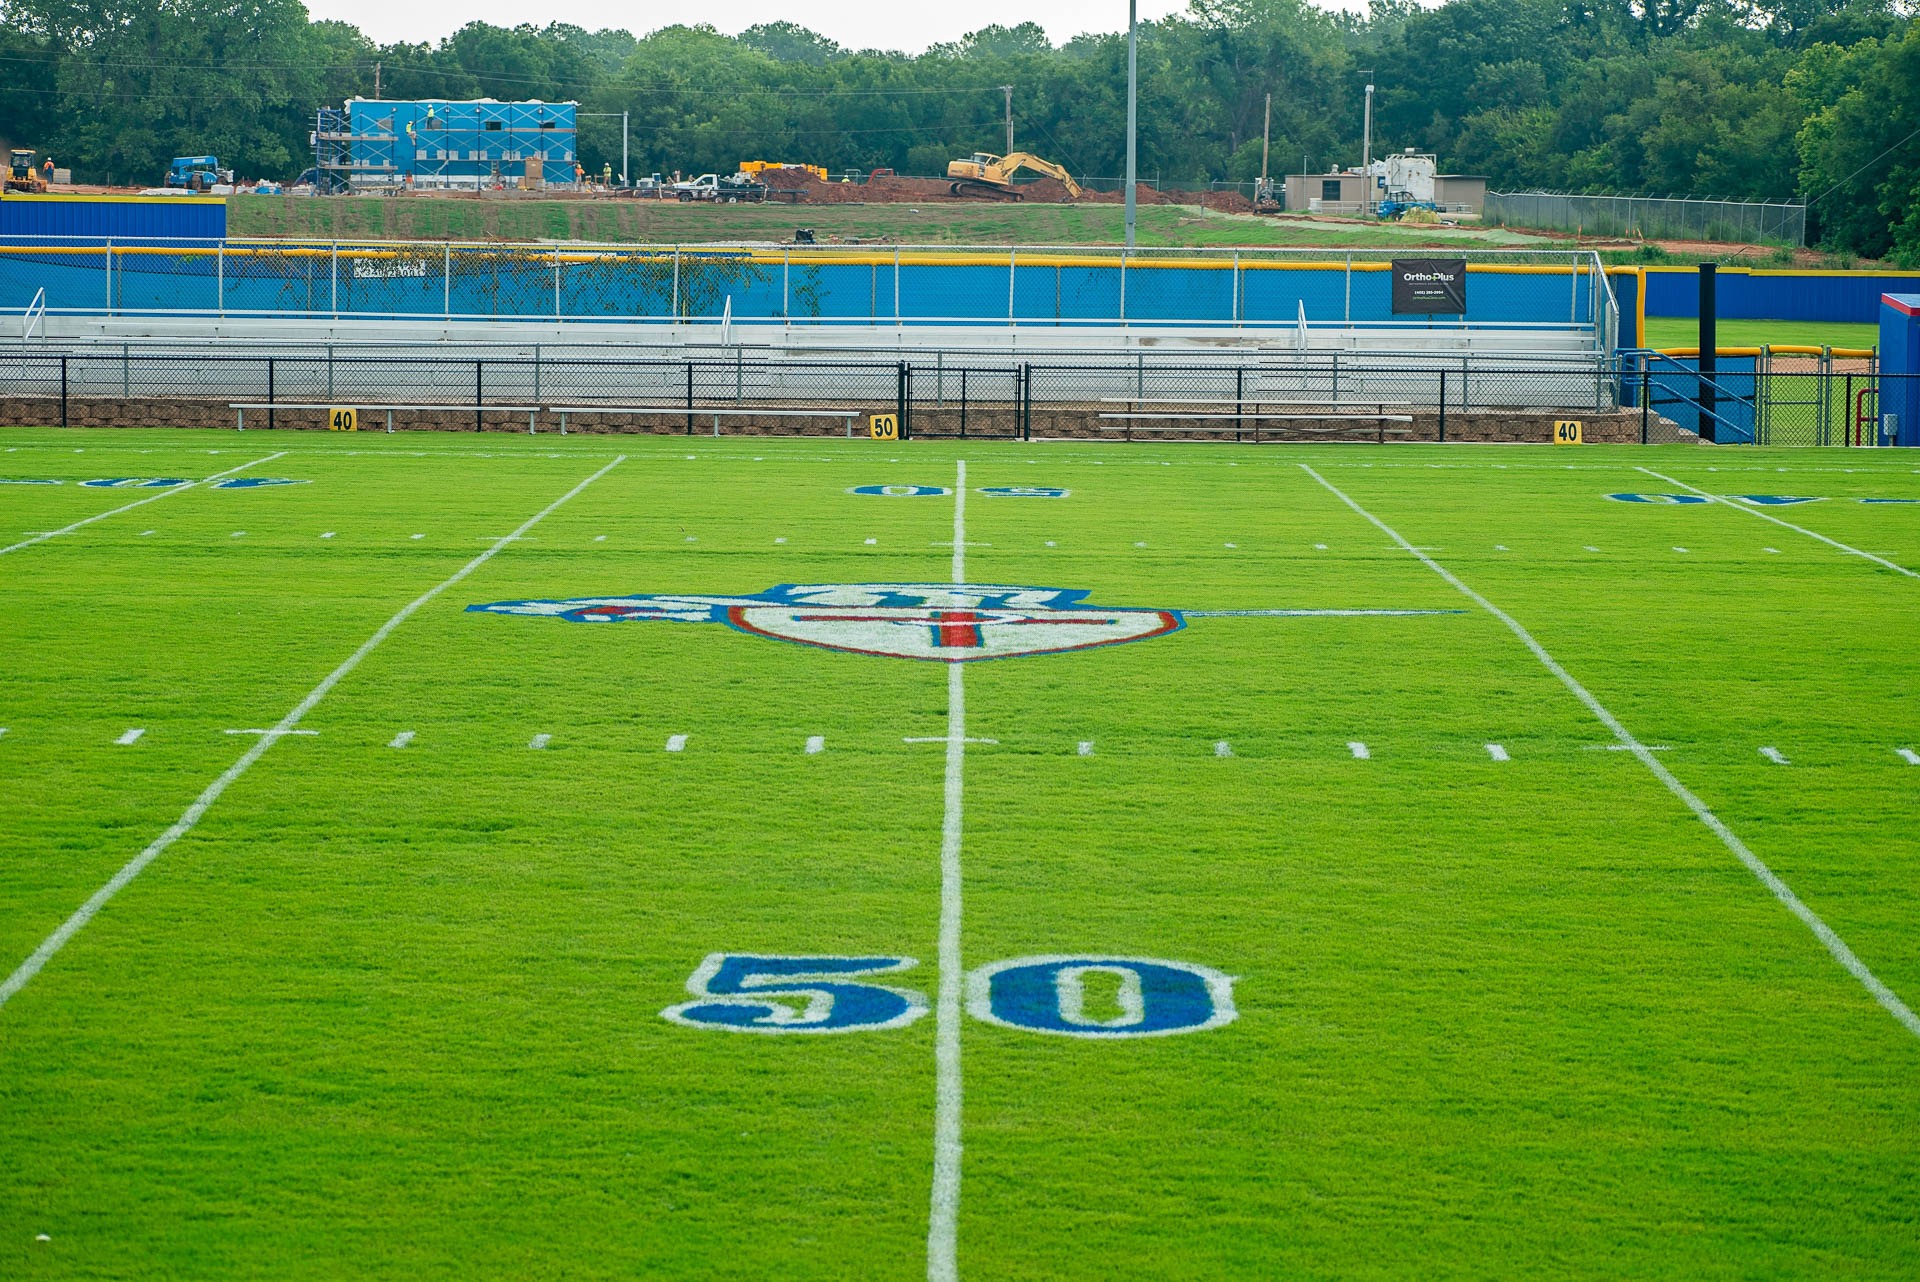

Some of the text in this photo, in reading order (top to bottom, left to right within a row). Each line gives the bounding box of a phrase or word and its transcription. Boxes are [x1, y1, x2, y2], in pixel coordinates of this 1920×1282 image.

[333, 411, 352, 430] 40
[874, 417, 893, 437] 50
[1558, 422, 1577, 441] 40
[658, 952, 1239, 1038] 50
